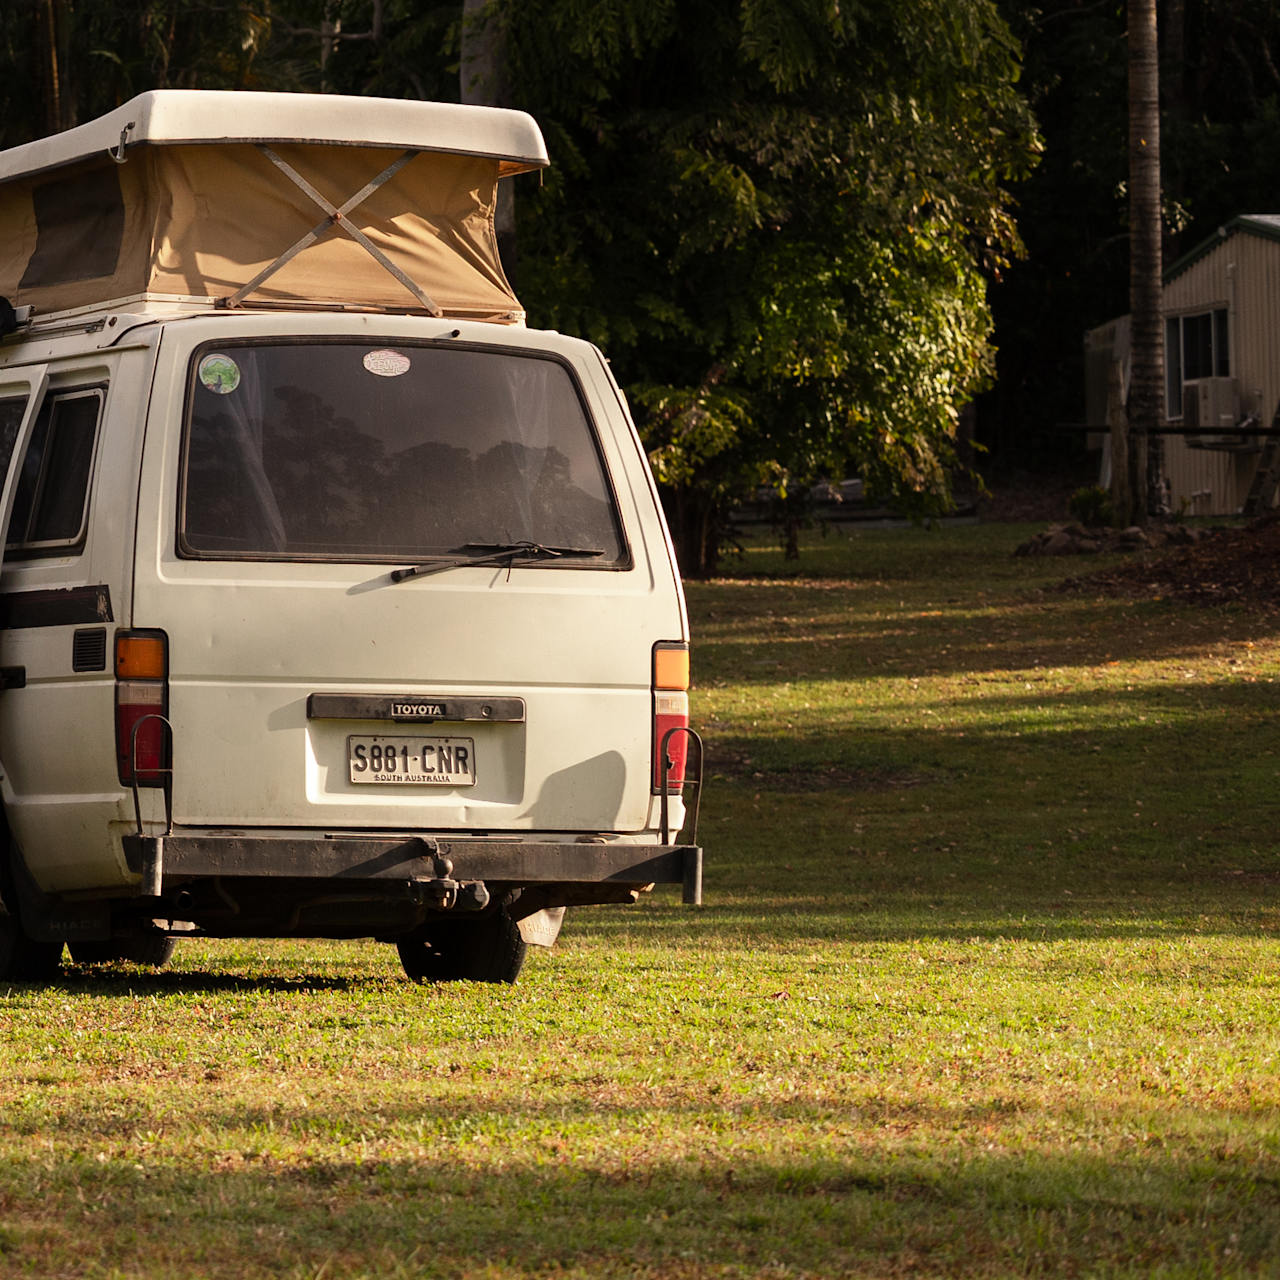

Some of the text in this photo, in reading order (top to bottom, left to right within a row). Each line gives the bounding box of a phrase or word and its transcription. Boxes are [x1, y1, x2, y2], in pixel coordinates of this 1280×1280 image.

[395, 704, 441, 715] TOYOTA
[375, 774, 451, 783] SOUTH AUSTRALIA
